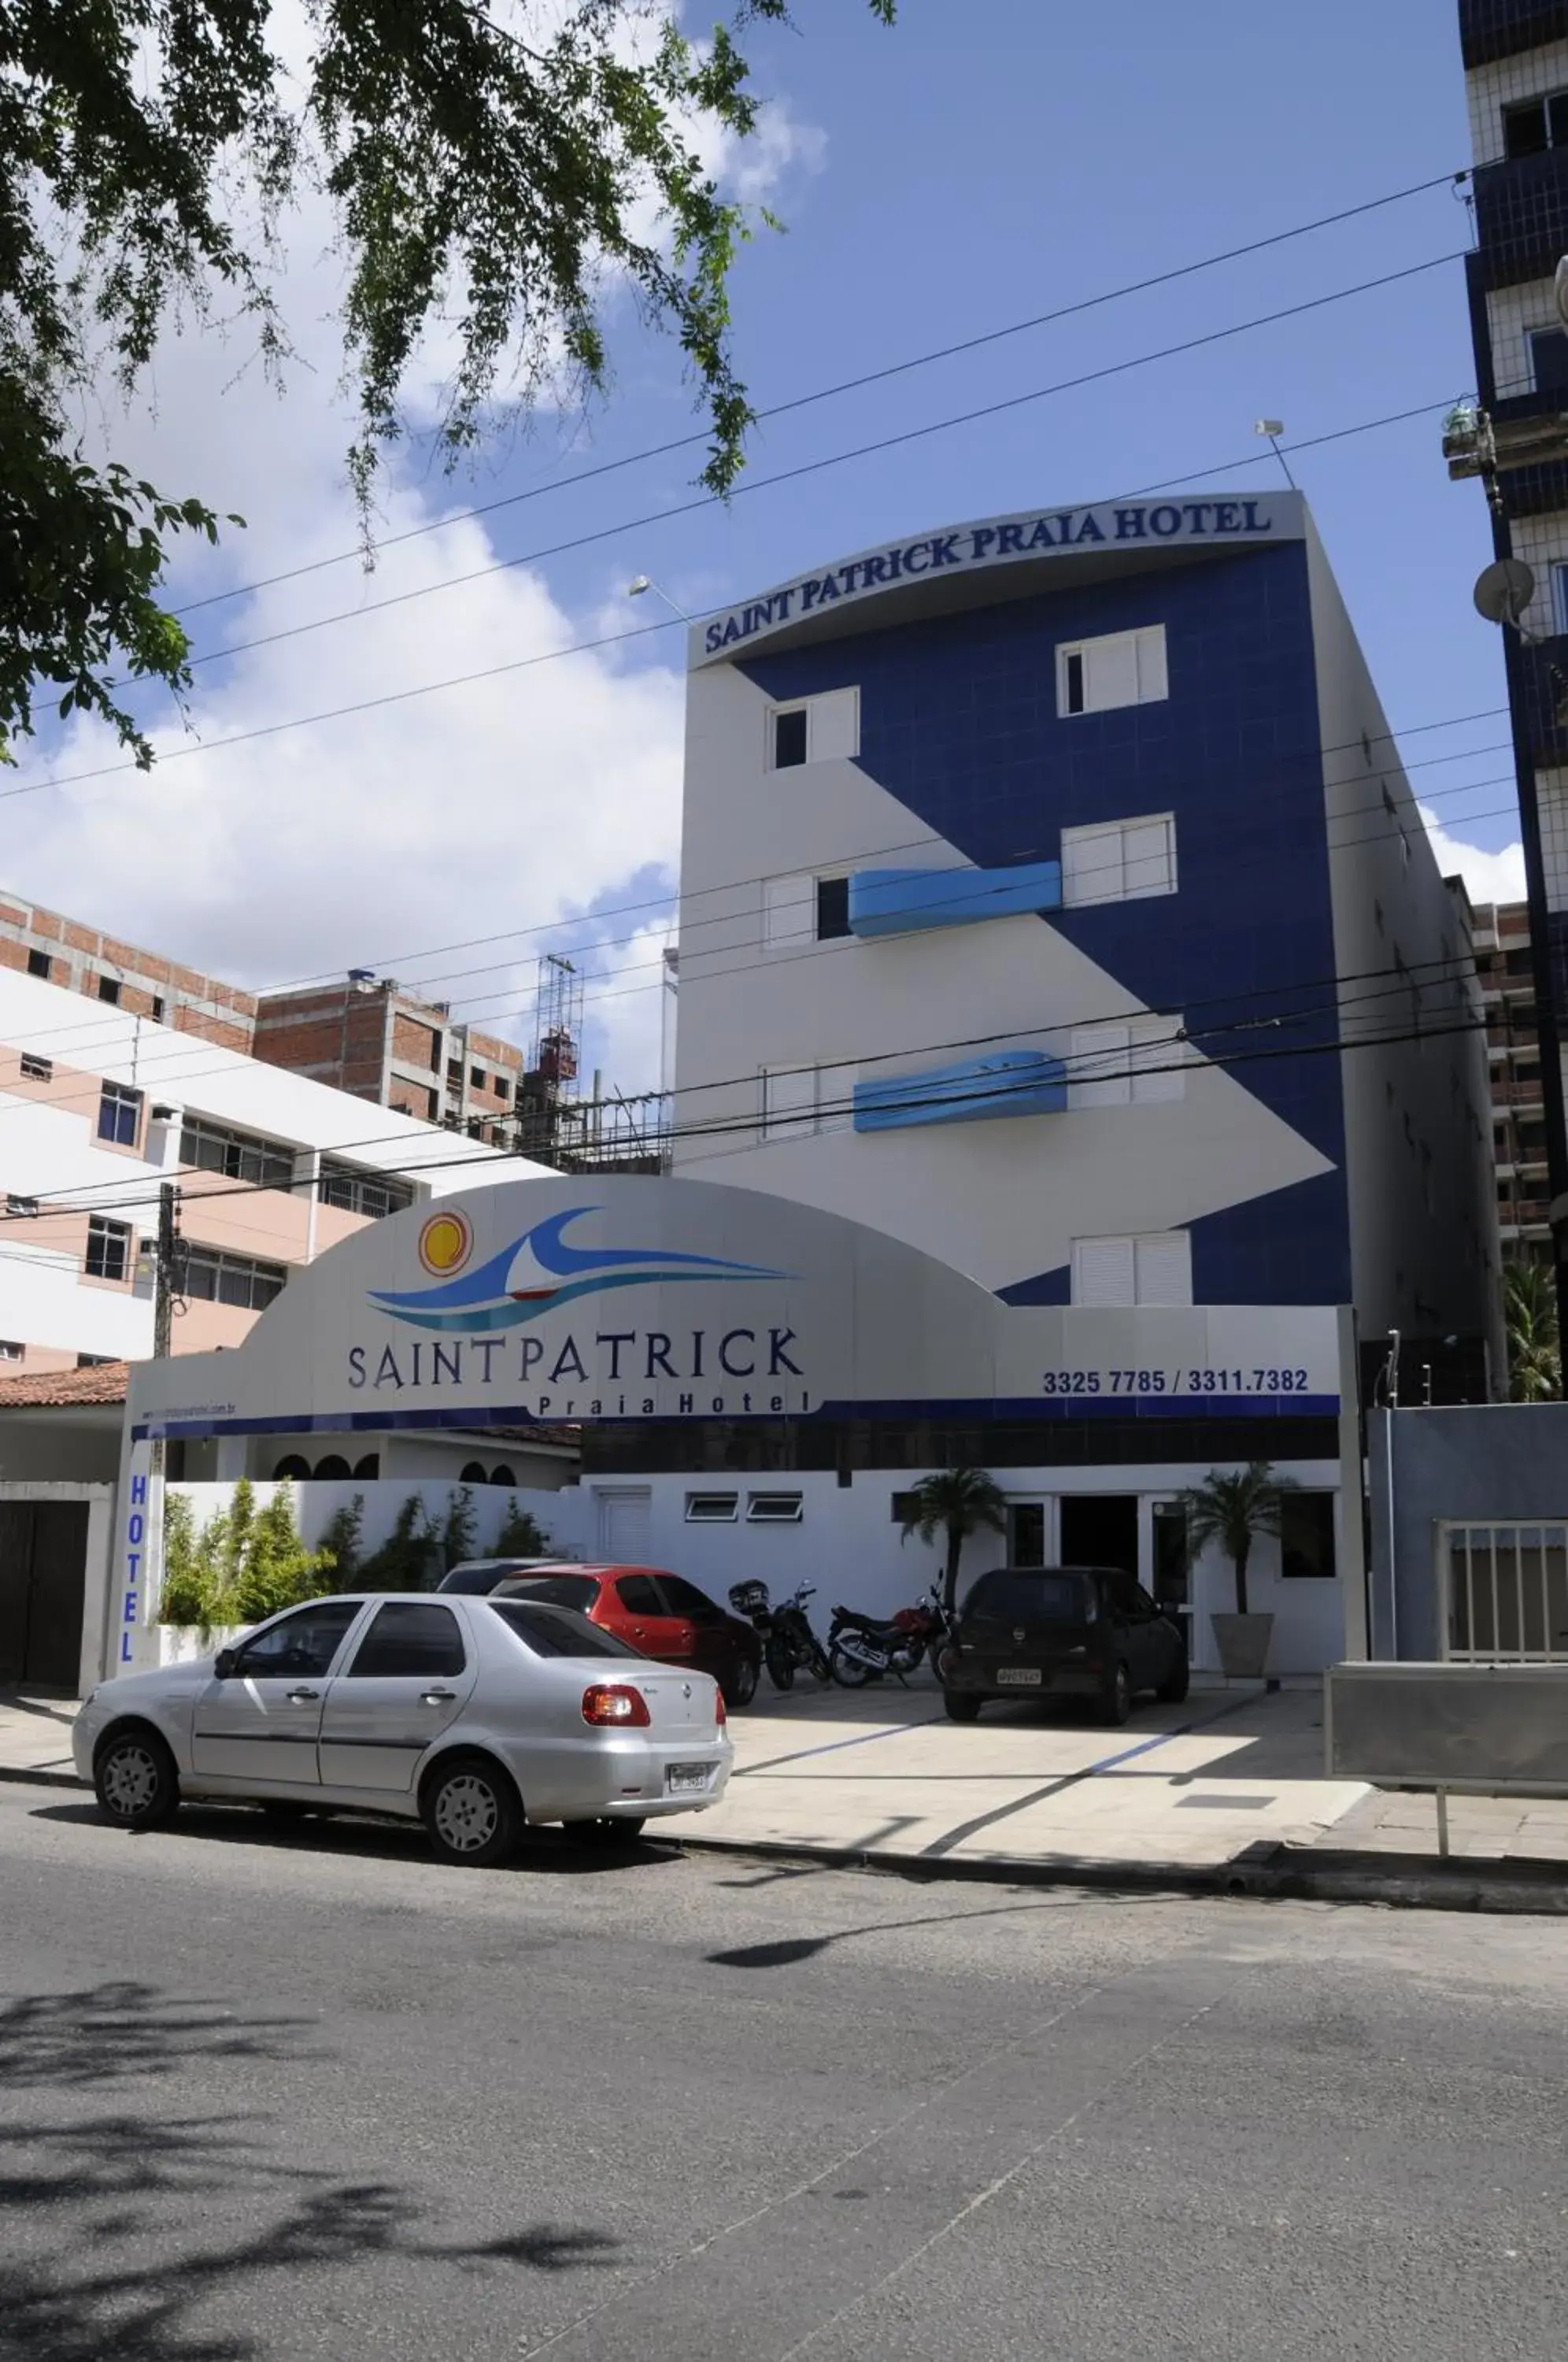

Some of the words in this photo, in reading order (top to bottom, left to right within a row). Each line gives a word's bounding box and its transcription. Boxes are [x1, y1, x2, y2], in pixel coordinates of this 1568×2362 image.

[704, 590, 795, 653] SAINT
[801, 533, 963, 611] PATRICK
[970, 511, 1107, 558] PRAIA
[1113, 500, 1272, 540] HOTEL
[348, 1336, 506, 1391] SAINT
[518, 1327, 804, 1384] PATRICK
[1043, 1372, 1100, 1394] 3325
[1108, 1370, 1166, 1393] 7785
[1189, 1369, 1308, 1391] 3311.7382
[540, 1396, 655, 1416] Praia
[679, 1391, 809, 1414] Hotel
[121, 1475, 146, 1662] HOTEL
